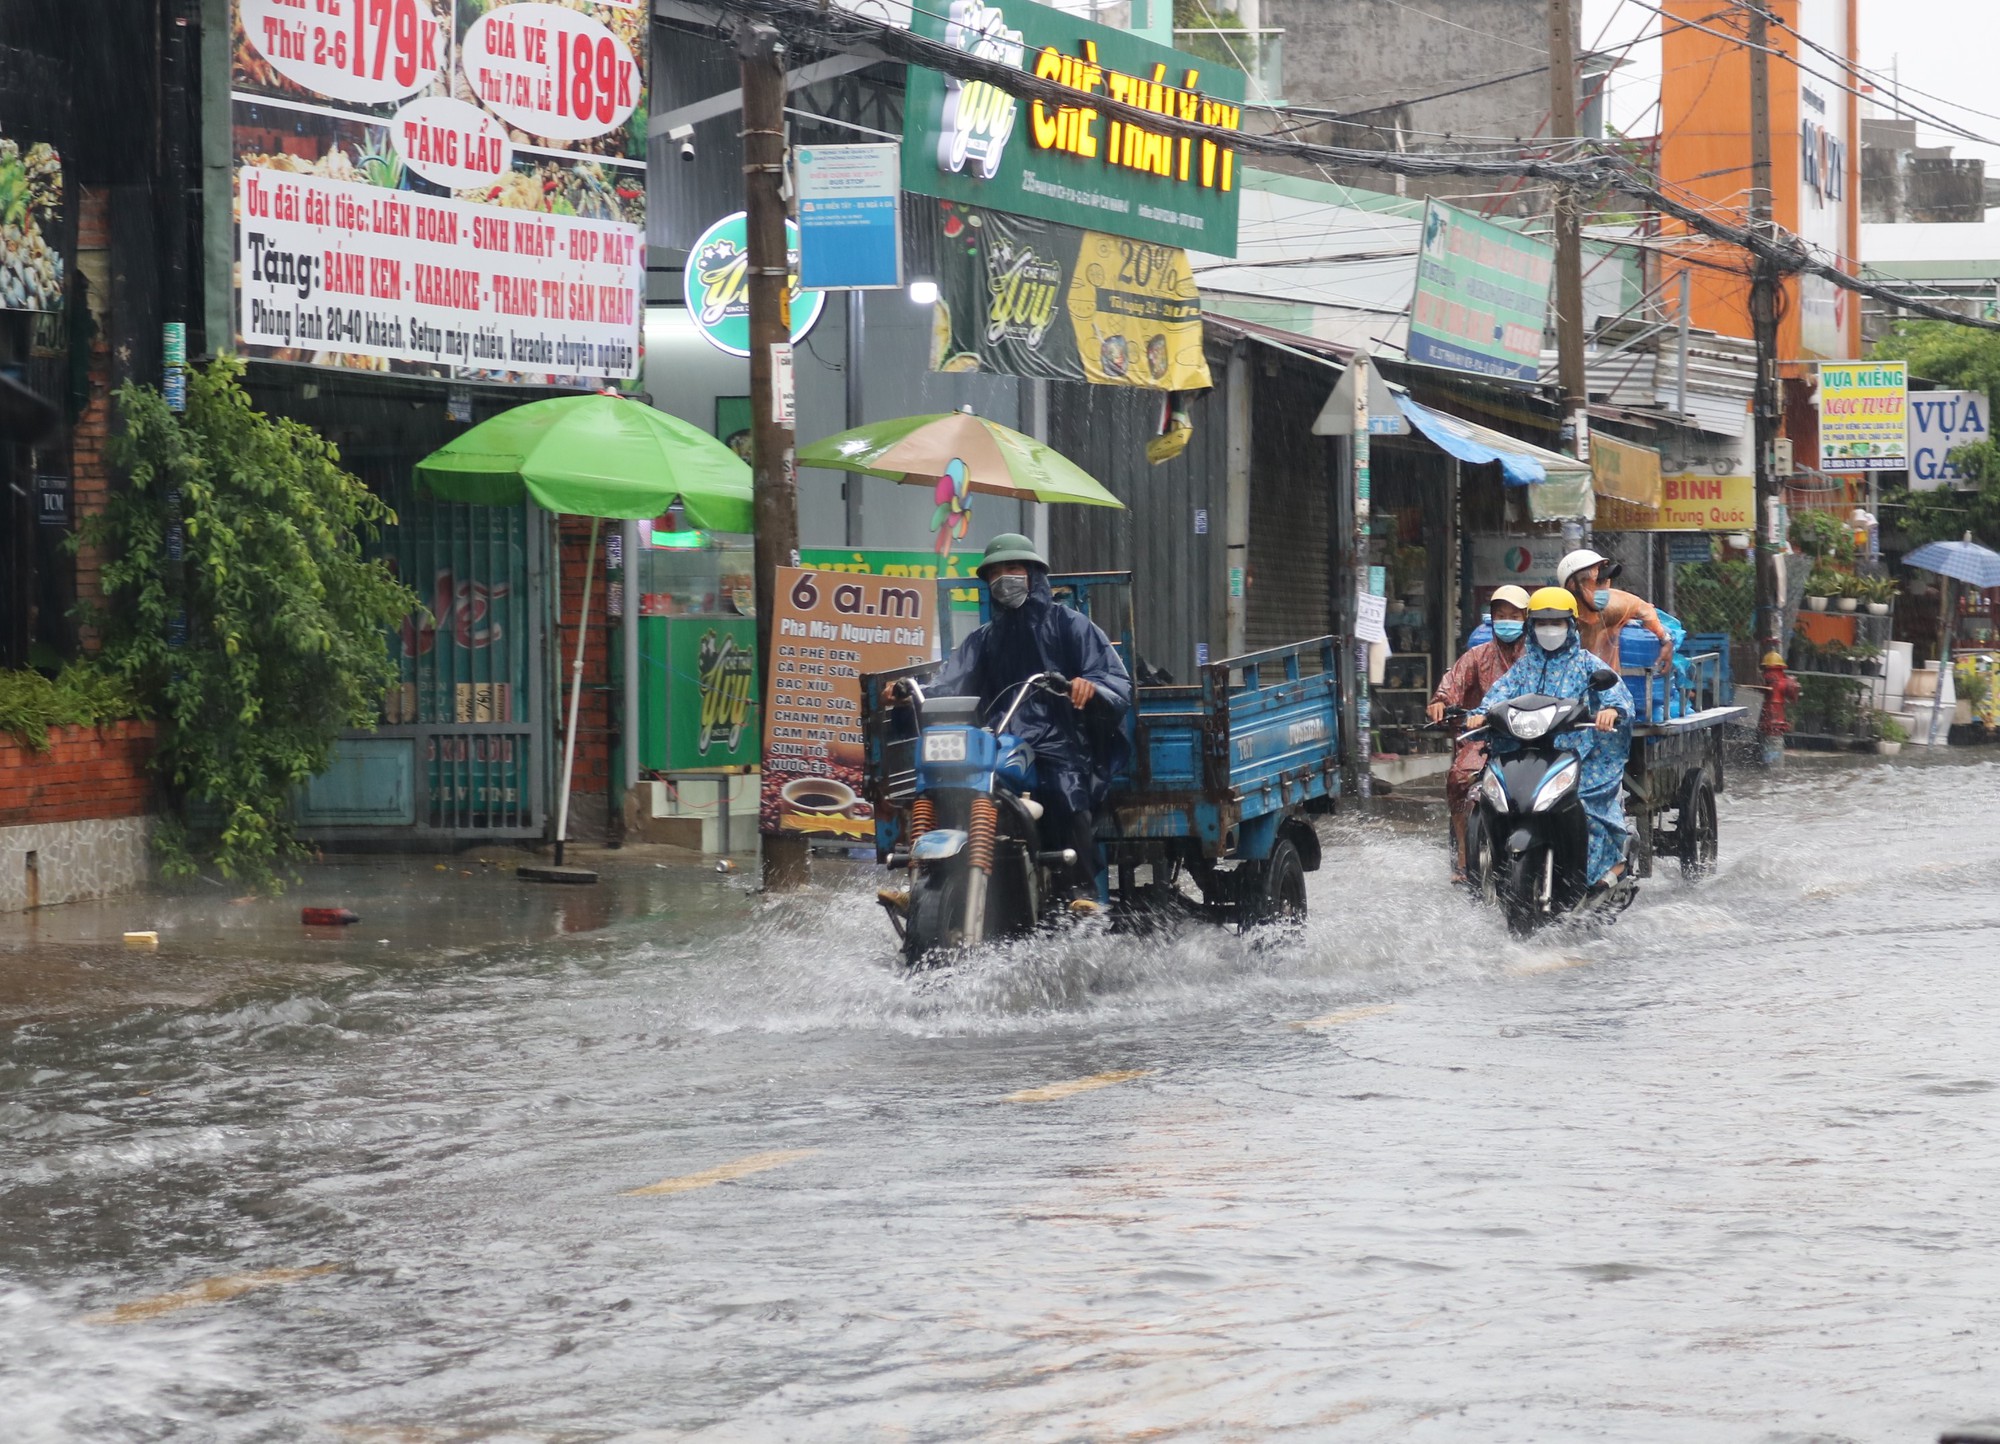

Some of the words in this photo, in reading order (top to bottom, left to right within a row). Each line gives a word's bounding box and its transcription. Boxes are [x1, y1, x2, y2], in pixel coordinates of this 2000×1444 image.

[263, 16, 306, 61] Thứ
[313, 26, 347, 69] 2-6
[484, 12, 517, 59] GIÁ
[523, 18, 547, 65] VÉ
[479, 66, 501, 103] Thứ
[1030, 39, 1101, 158] CHÈ
[1107, 63, 1175, 177] THÁI
[1200, 98, 1240, 192] VY
[403, 116, 458, 171] TẶNG
[464, 118, 503, 175] LẨU
[247, 171, 268, 217] Ưu
[274, 182, 300, 222] đãi
[305, 187, 330, 234] đặt
[335, 192, 370, 239] tiệc:
[372, 193, 411, 238] LIÊN
[416, 206, 458, 245] HOAN
[472, 215, 509, 252] SINH
[514, 216, 556, 264] NHẬT
[569, 228, 599, 269] HỌP
[603, 227, 635, 272] MẶT
[248, 231, 320, 300] Tặng:
[324, 240, 365, 296] BÁNH
[369, 256, 401, 300] KEM
[415, 263, 480, 311] KARAOKE
[492, 274, 537, 318] TRANG
[542, 272, 565, 320] TRÍ
[568, 273, 595, 322] SÂN
[599, 273, 634, 326] KHẤU
[251, 298, 291, 346] Phòng
[295, 302, 323, 347] lạnh
[327, 306, 362, 344] 20-40
[410, 316, 442, 361] Setup
[446, 322, 470, 365] máy
[510, 329, 553, 364] karaoke
[556, 333, 594, 373] chuyên
[598, 337, 633, 377] nghiệp
[1823, 371, 1852, 391] VỰA
[1912, 395, 1985, 441] VỰA
[1914, 448, 1979, 488] GẠ
[1664, 507, 1704, 526] Trung
[1710, 507, 1745, 523] Quốc
[790, 572, 820, 611] 6
[832, 583, 922, 620] a.m
[780, 618, 806, 637] Pha
[810, 620, 839, 641] Máy
[841, 623, 891, 644] Nguyên
[894, 626, 925, 647] Chất
[799, 645, 825, 660] PHÊ
[829, 649, 861, 662] ĐEN:
[799, 661, 824, 675] PHÊ
[774, 711, 819, 724] CHANH
[796, 696, 822, 708] CAO
[772, 742, 803, 756] SINH
[773, 726, 802, 739] CAM
[806, 728, 836, 743] MẬT
